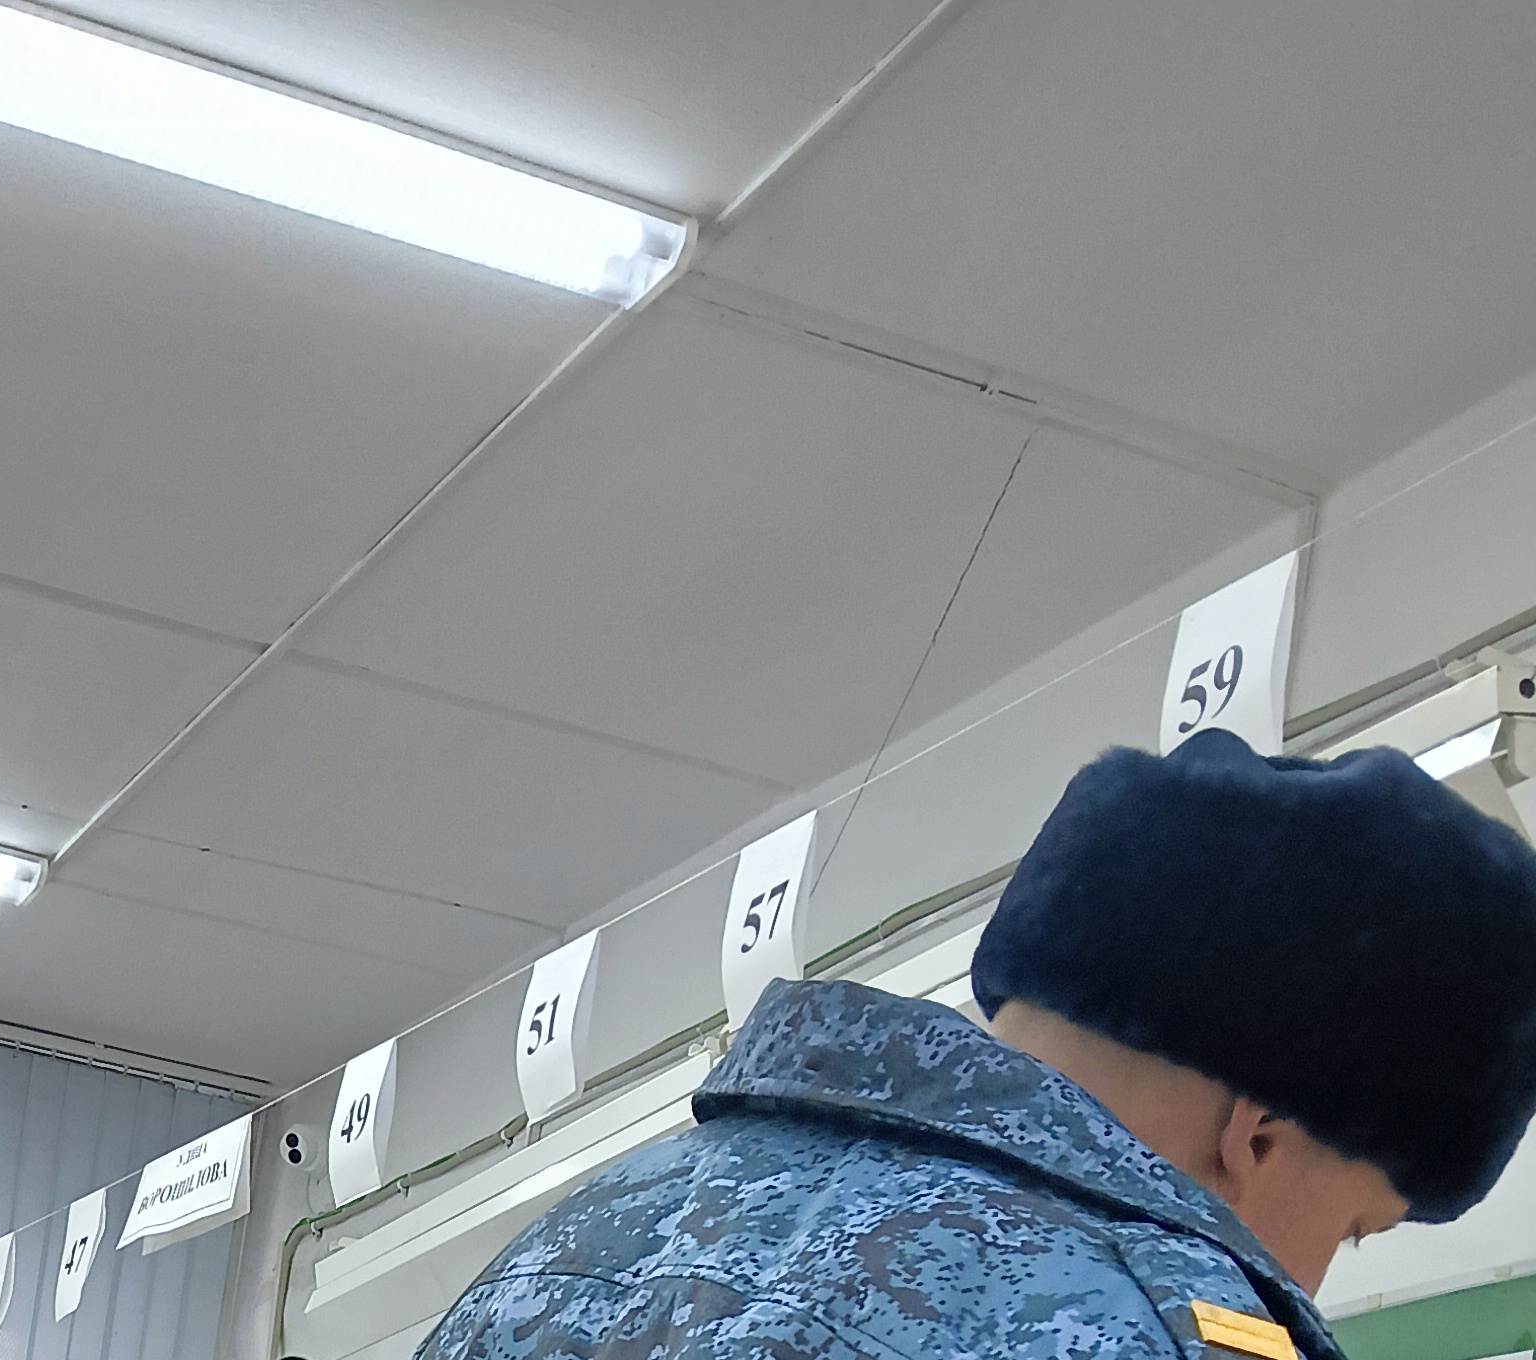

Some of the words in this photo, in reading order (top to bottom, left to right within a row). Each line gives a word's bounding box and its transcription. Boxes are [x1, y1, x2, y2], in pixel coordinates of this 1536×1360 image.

[1178, 644, 1243, 734] 59
[740, 879, 789, 953] 57
[526, 992, 561, 1056] 51
[340, 1092, 371, 1144] 49
[64, 1235, 89, 1276] 47
